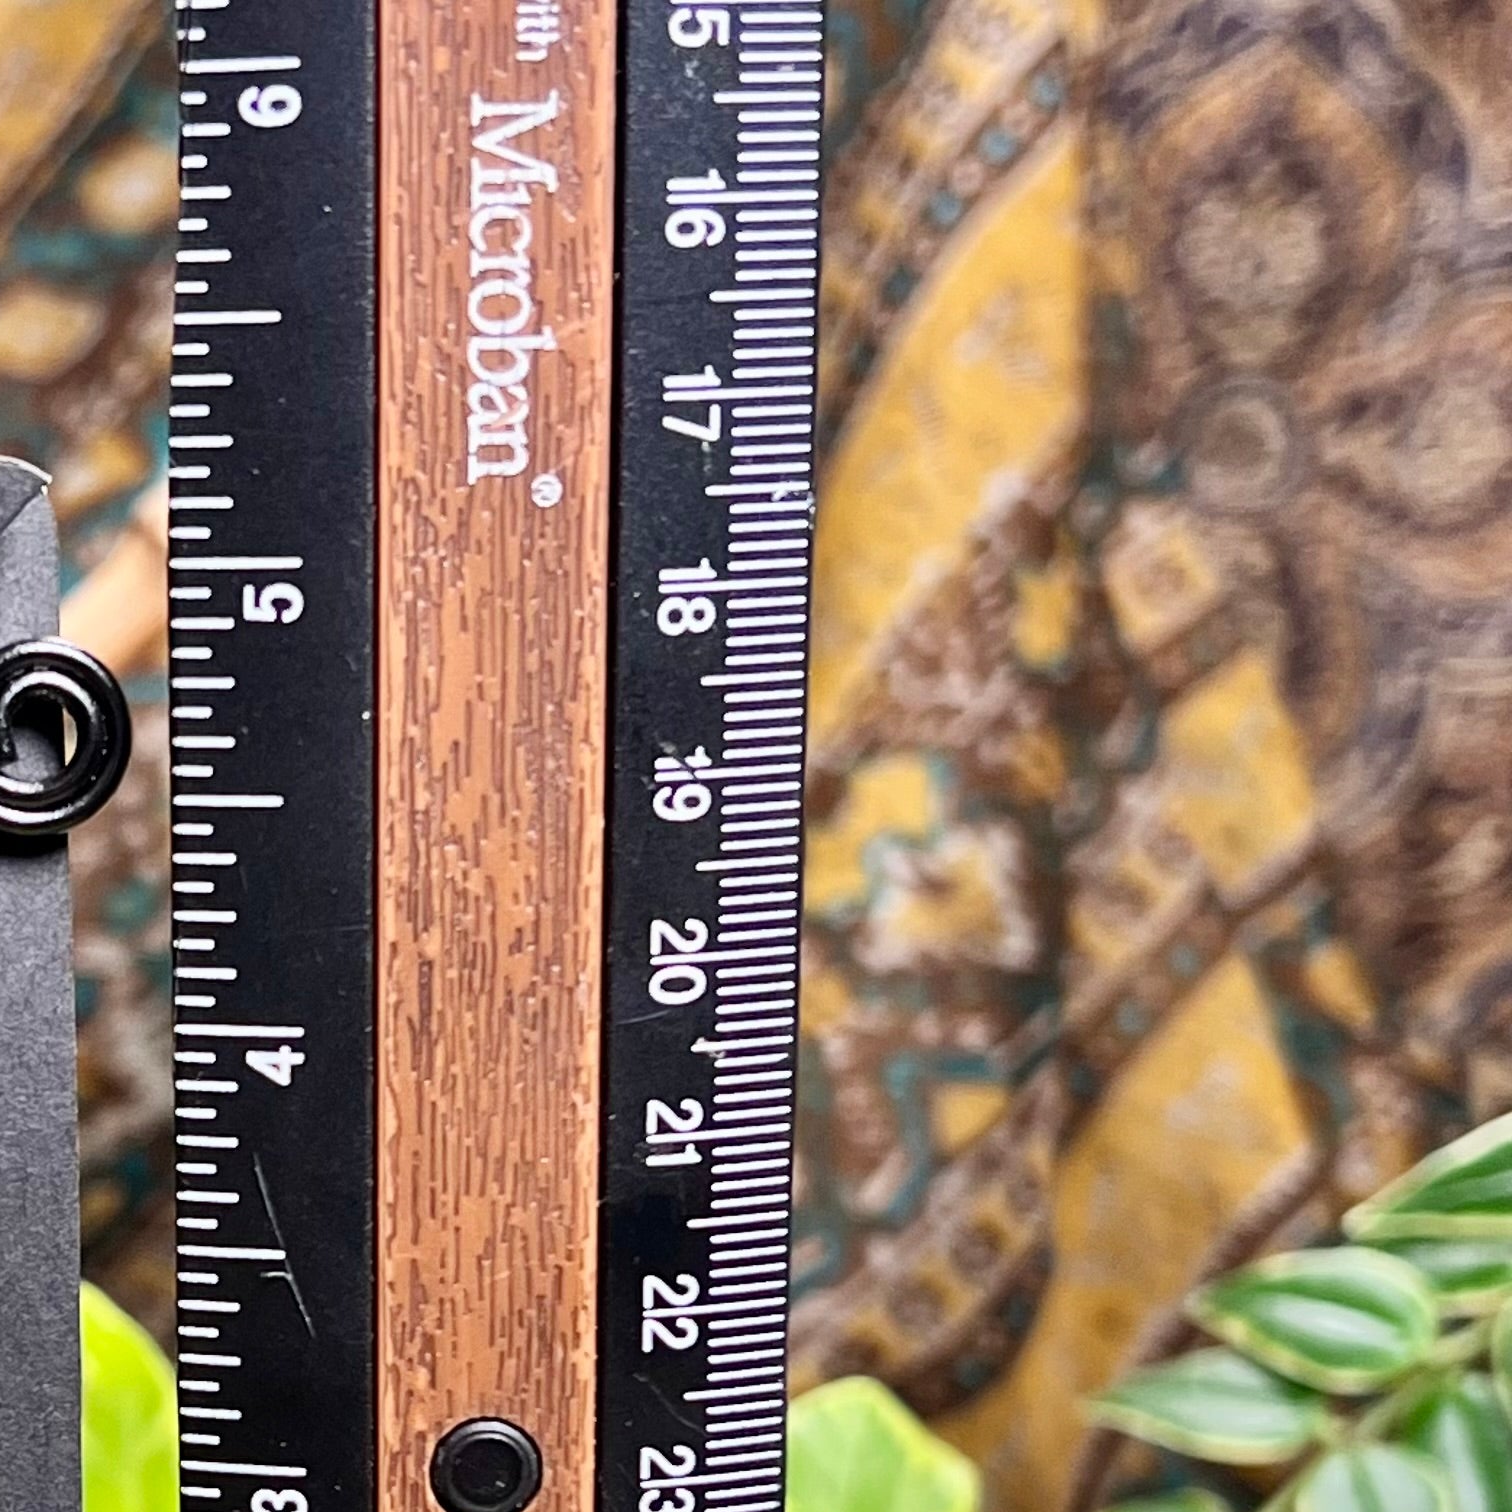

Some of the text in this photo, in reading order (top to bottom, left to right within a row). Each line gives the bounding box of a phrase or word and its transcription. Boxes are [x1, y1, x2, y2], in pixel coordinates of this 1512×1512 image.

[238, 84, 302, 127] 6
[665, 169, 726, 249] 16
[662, 365, 721, 442] 17
[243, 582, 304, 624] 5
[656, 558, 718, 637] 18
[653, 746, 713, 823] 19
[648, 918, 709, 1006] 20
[245, 1045, 306, 1086] 4
[645, 1098, 704, 1167] 21
[641, 1274, 700, 1353] 22
